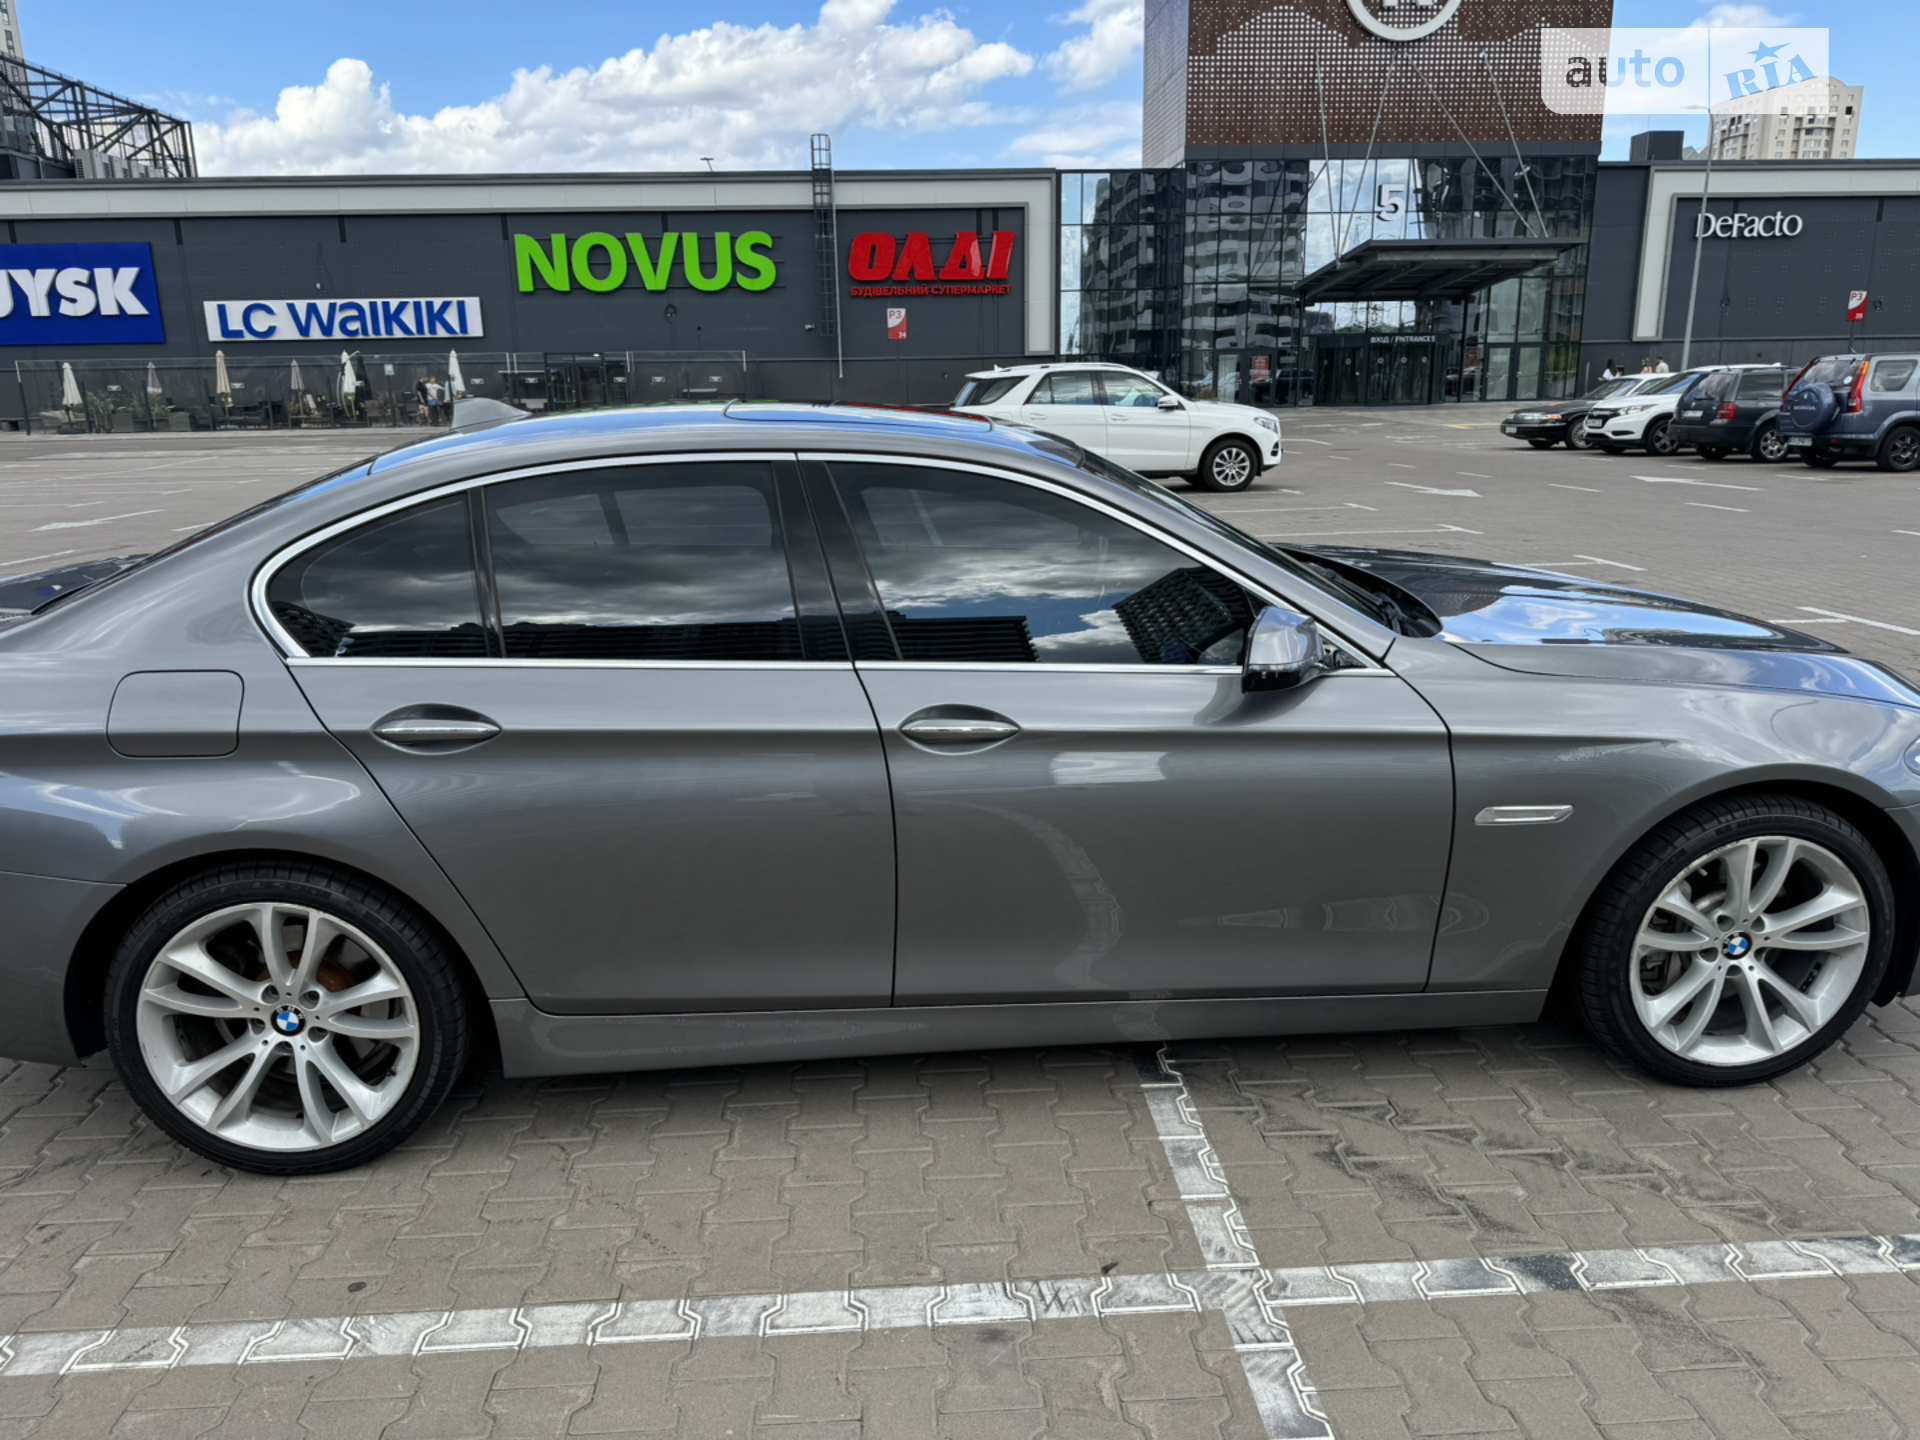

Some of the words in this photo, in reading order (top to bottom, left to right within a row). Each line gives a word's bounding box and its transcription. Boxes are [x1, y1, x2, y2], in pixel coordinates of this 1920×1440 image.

[1376, 184, 1406, 222] 5
[1695, 210, 1804, 238] DeFacto
[513, 231, 778, 293] NOVUS
[847, 231, 1016, 281] ОЛДІ
[931, 284, 1014, 296] СУПЕРМАРКЕТ
[216, 302, 278, 340] LC
[888, 310, 902, 320] P3
